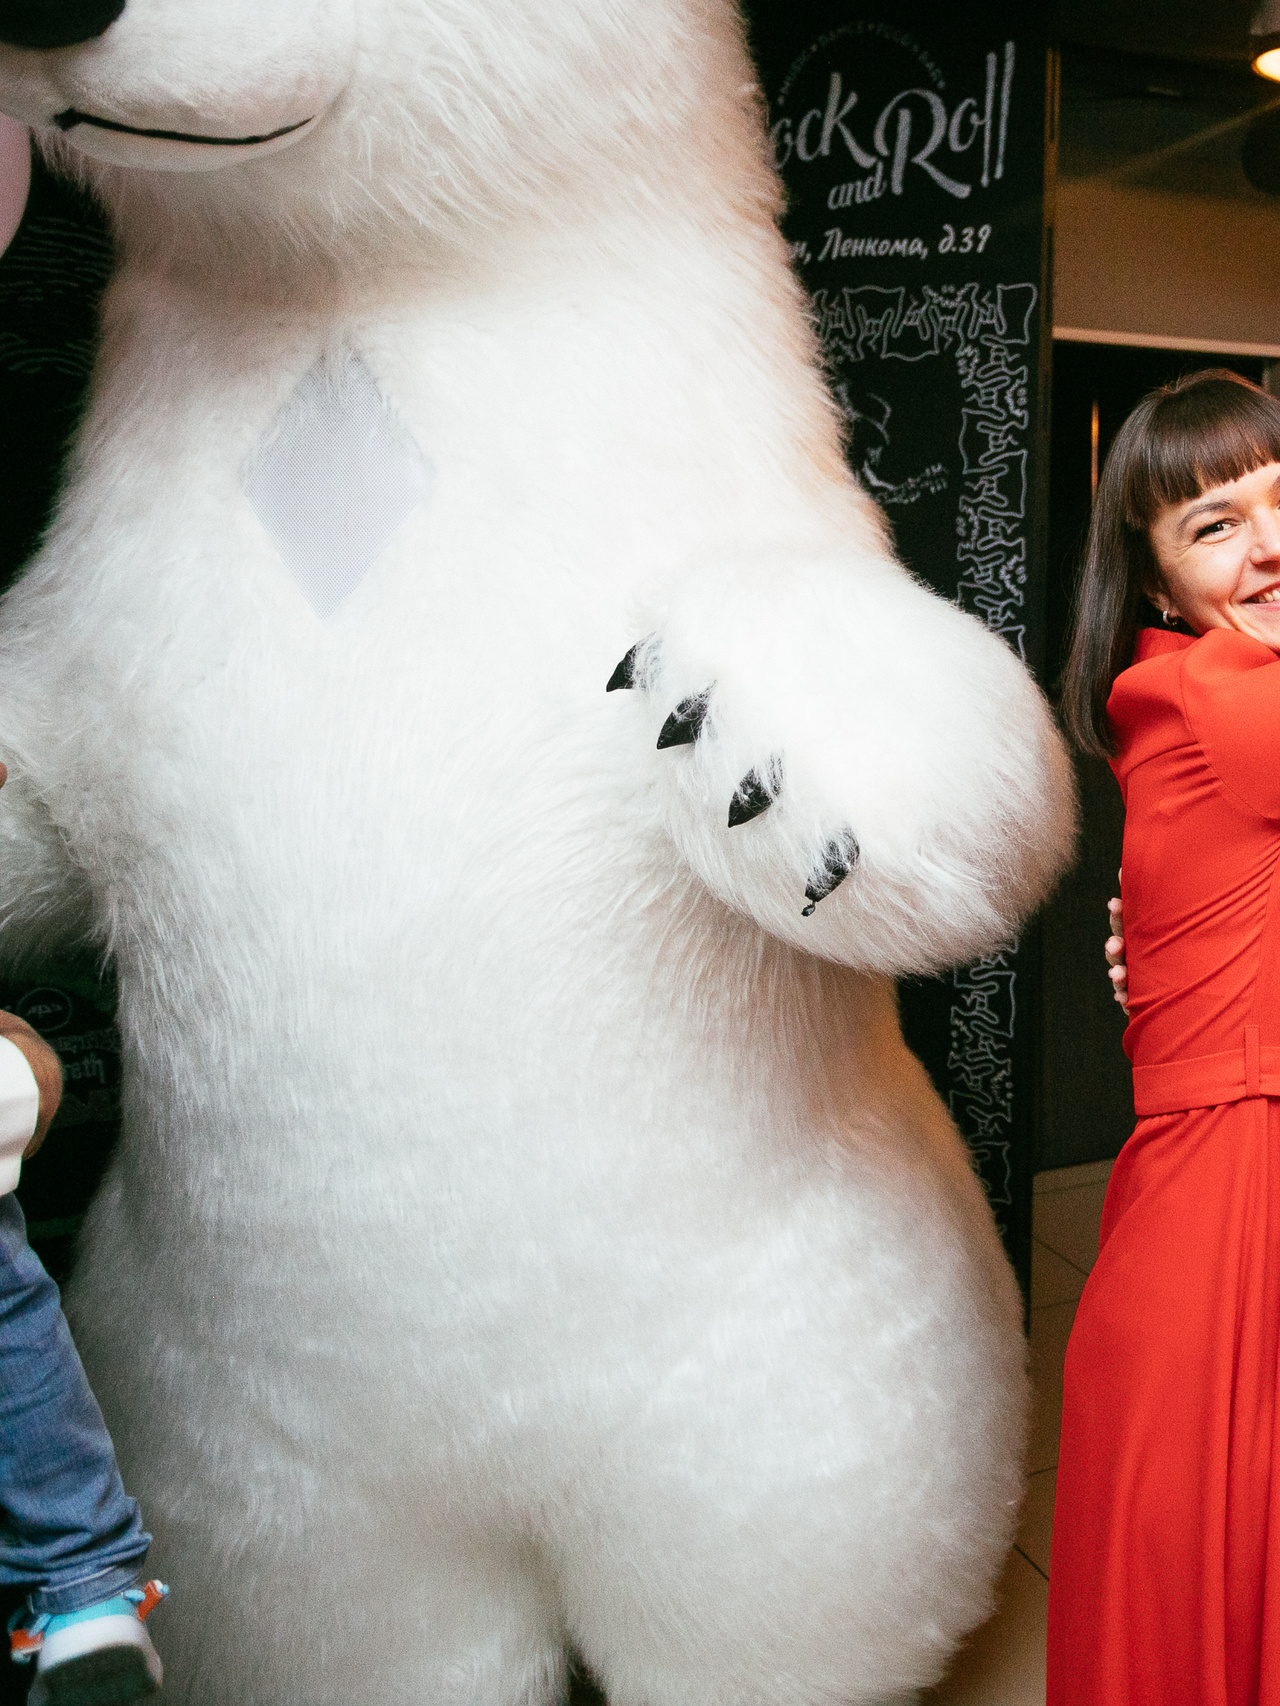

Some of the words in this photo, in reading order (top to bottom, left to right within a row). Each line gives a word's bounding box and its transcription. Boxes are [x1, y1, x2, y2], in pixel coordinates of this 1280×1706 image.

[767, 72, 878, 170] ock
[873, 40, 1015, 200] Roll
[827, 160, 887, 210] and
[817, 226, 929, 262] Ленкома,
[937, 223, 992, 254] д.39
